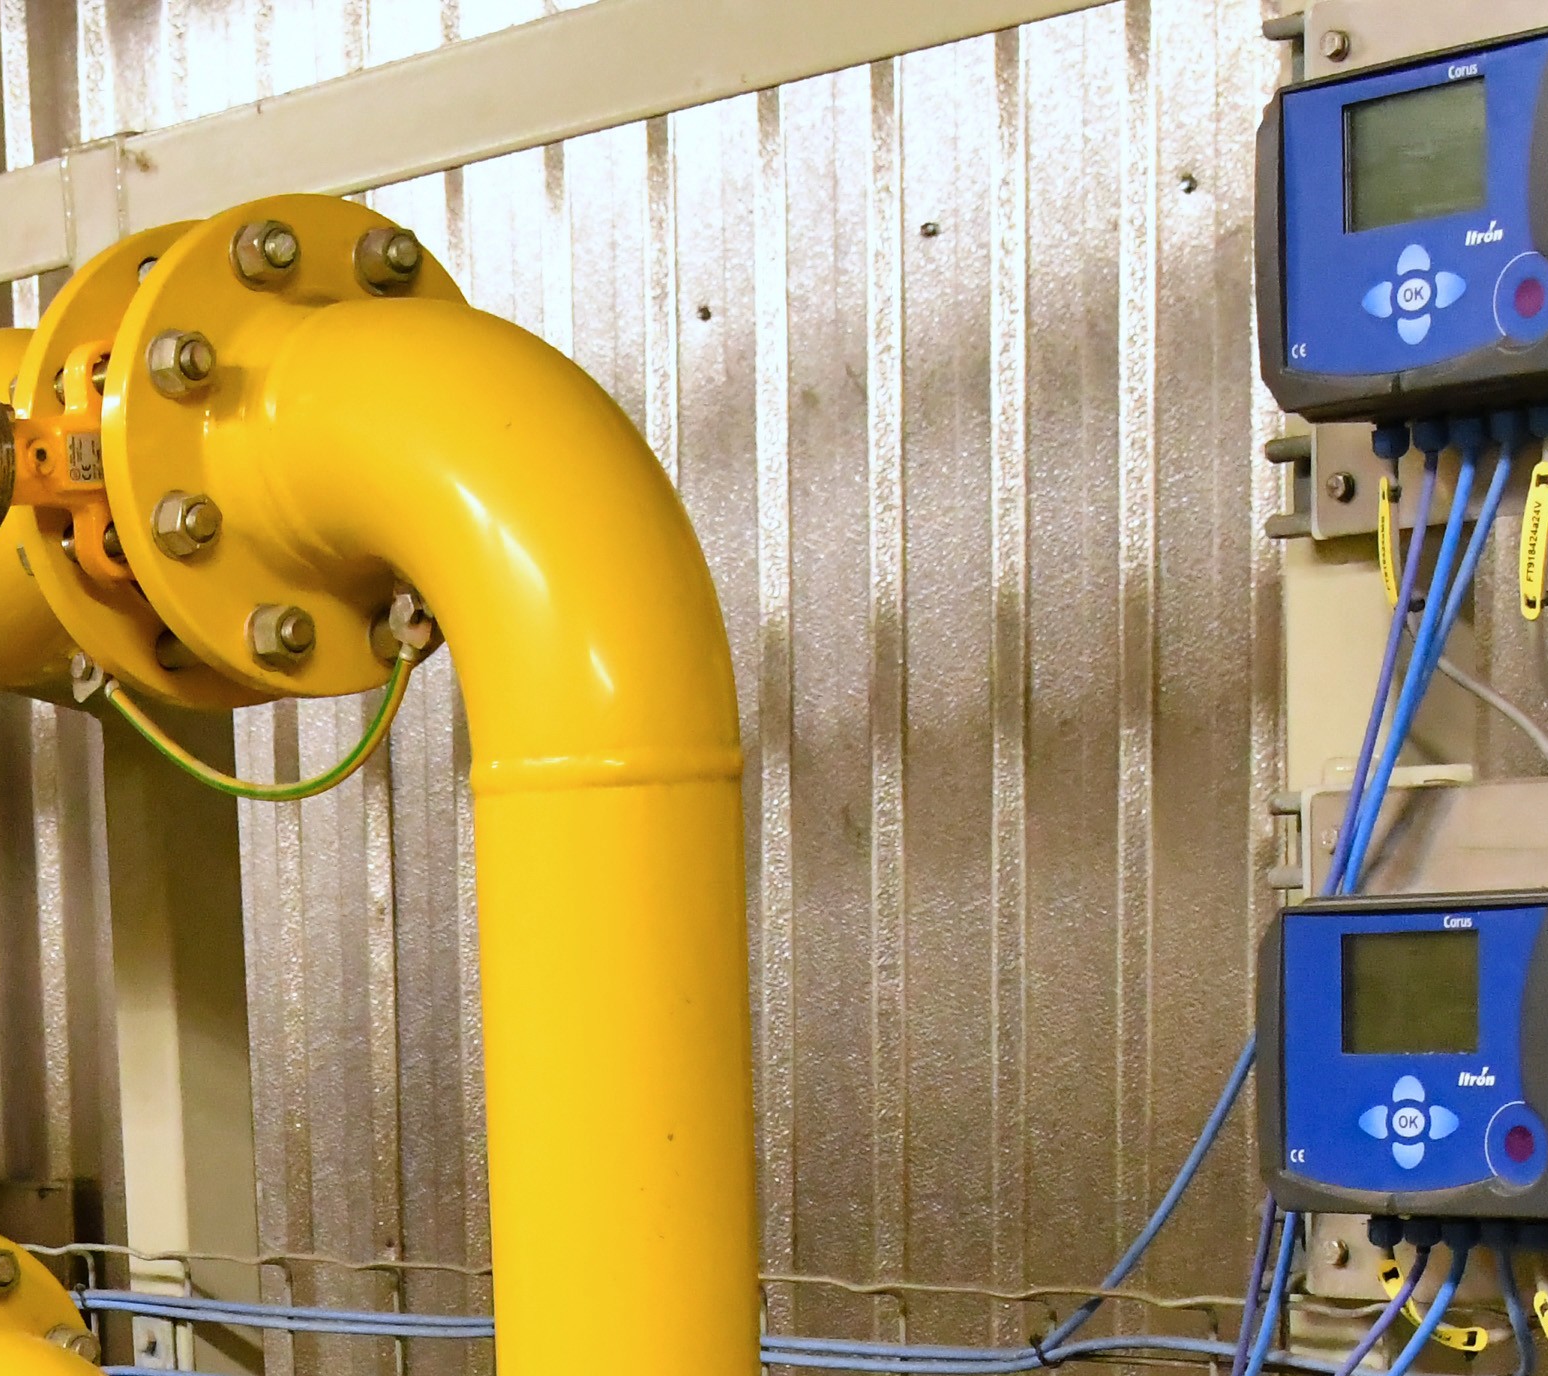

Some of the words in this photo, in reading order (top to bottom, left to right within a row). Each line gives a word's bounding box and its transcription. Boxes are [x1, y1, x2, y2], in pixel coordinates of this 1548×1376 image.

[1448, 63, 1478, 79] Corus
[1465, 220, 1503, 247] Itron
[1402, 286, 1424, 303] OK
[1443, 914, 1473, 928] Corus
[1458, 1066, 1495, 1086] Itron
[1398, 1115, 1419, 1130] OK
